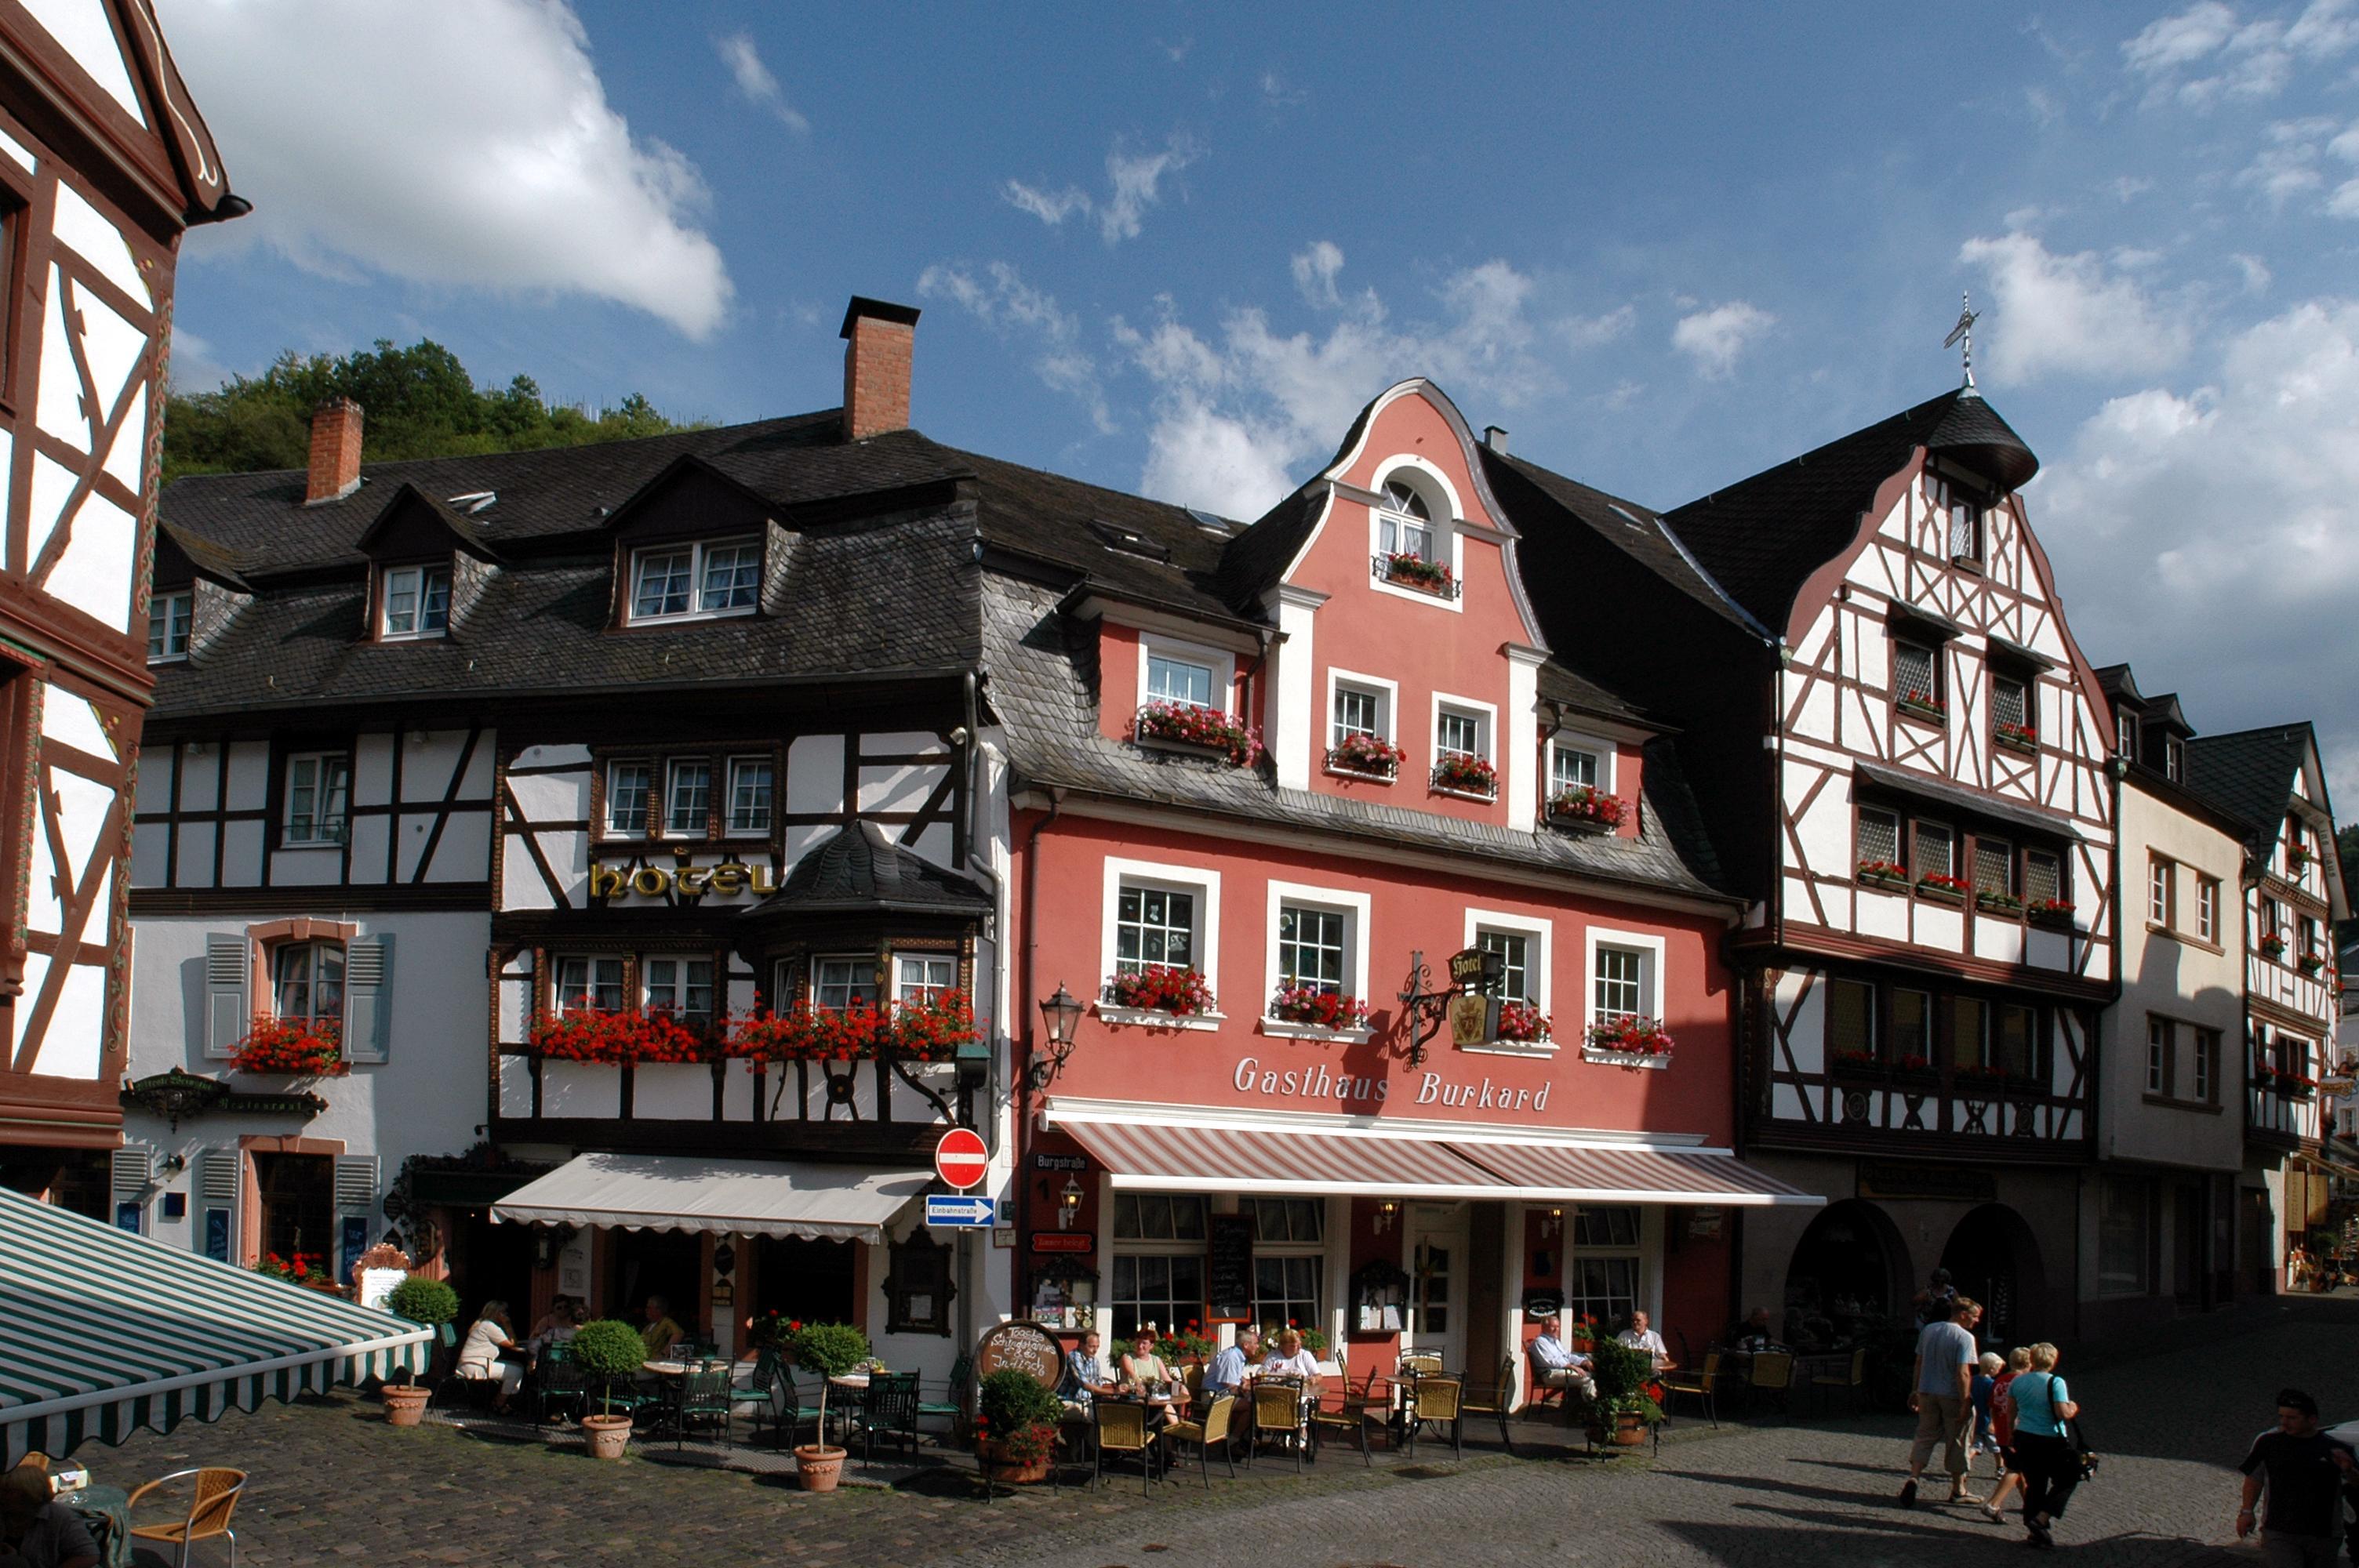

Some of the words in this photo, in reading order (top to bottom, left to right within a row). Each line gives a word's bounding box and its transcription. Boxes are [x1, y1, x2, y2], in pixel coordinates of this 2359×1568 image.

[1452, 954, 1482, 980] Hotel
[1234, 1057, 1389, 1102] Gasthaus
[1414, 1072, 1551, 1112] Burkard
[1037, 1155, 1086, 1171] Burgstraße
[932, 1206, 977, 1214] Einbahnstraße
